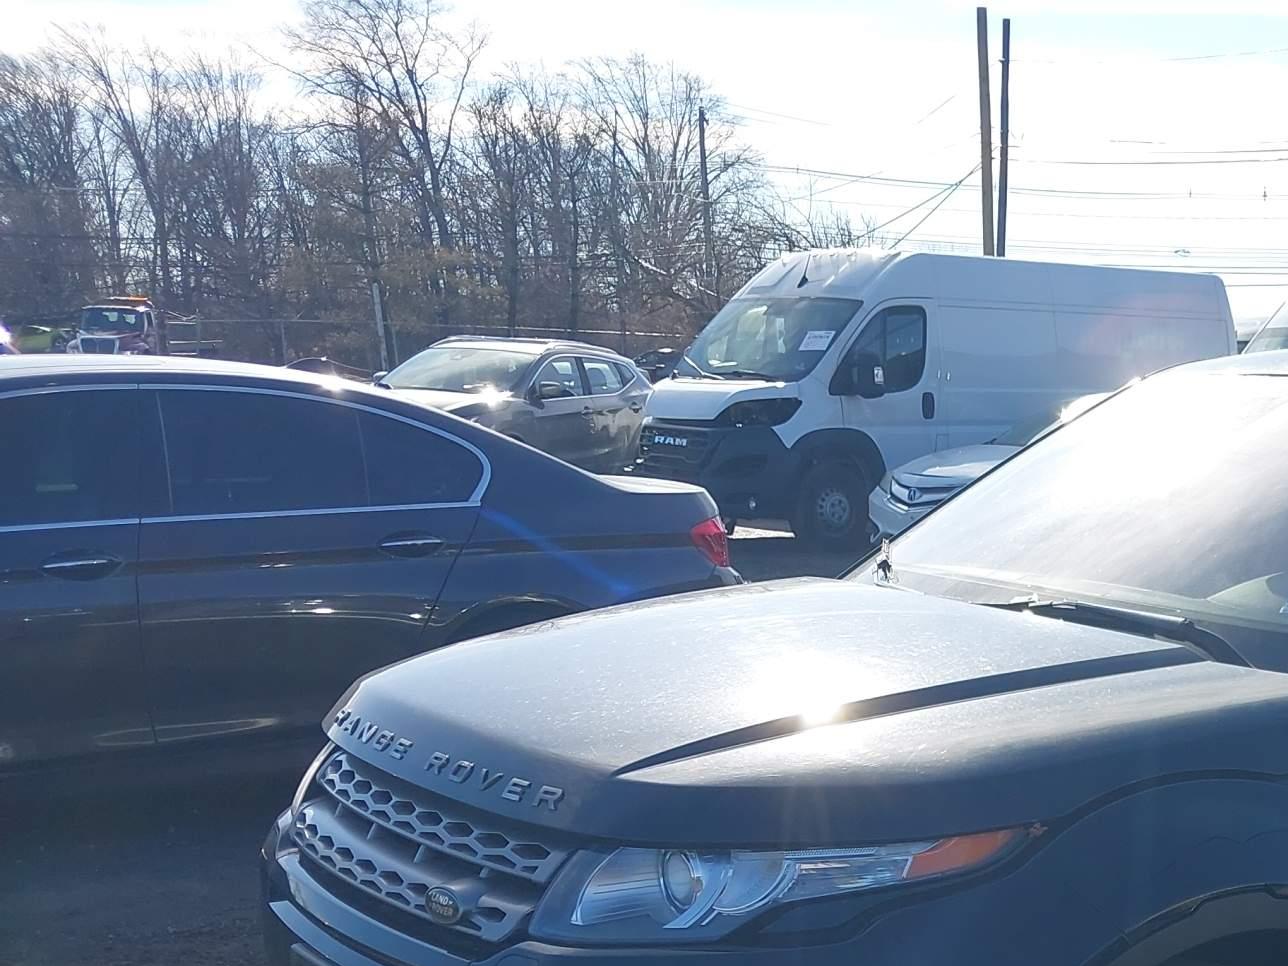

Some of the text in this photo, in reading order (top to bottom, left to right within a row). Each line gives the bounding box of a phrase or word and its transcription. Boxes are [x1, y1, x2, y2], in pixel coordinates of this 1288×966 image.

[654, 435, 688, 447] RAM
[334, 708, 566, 811] RANGE ROVER
